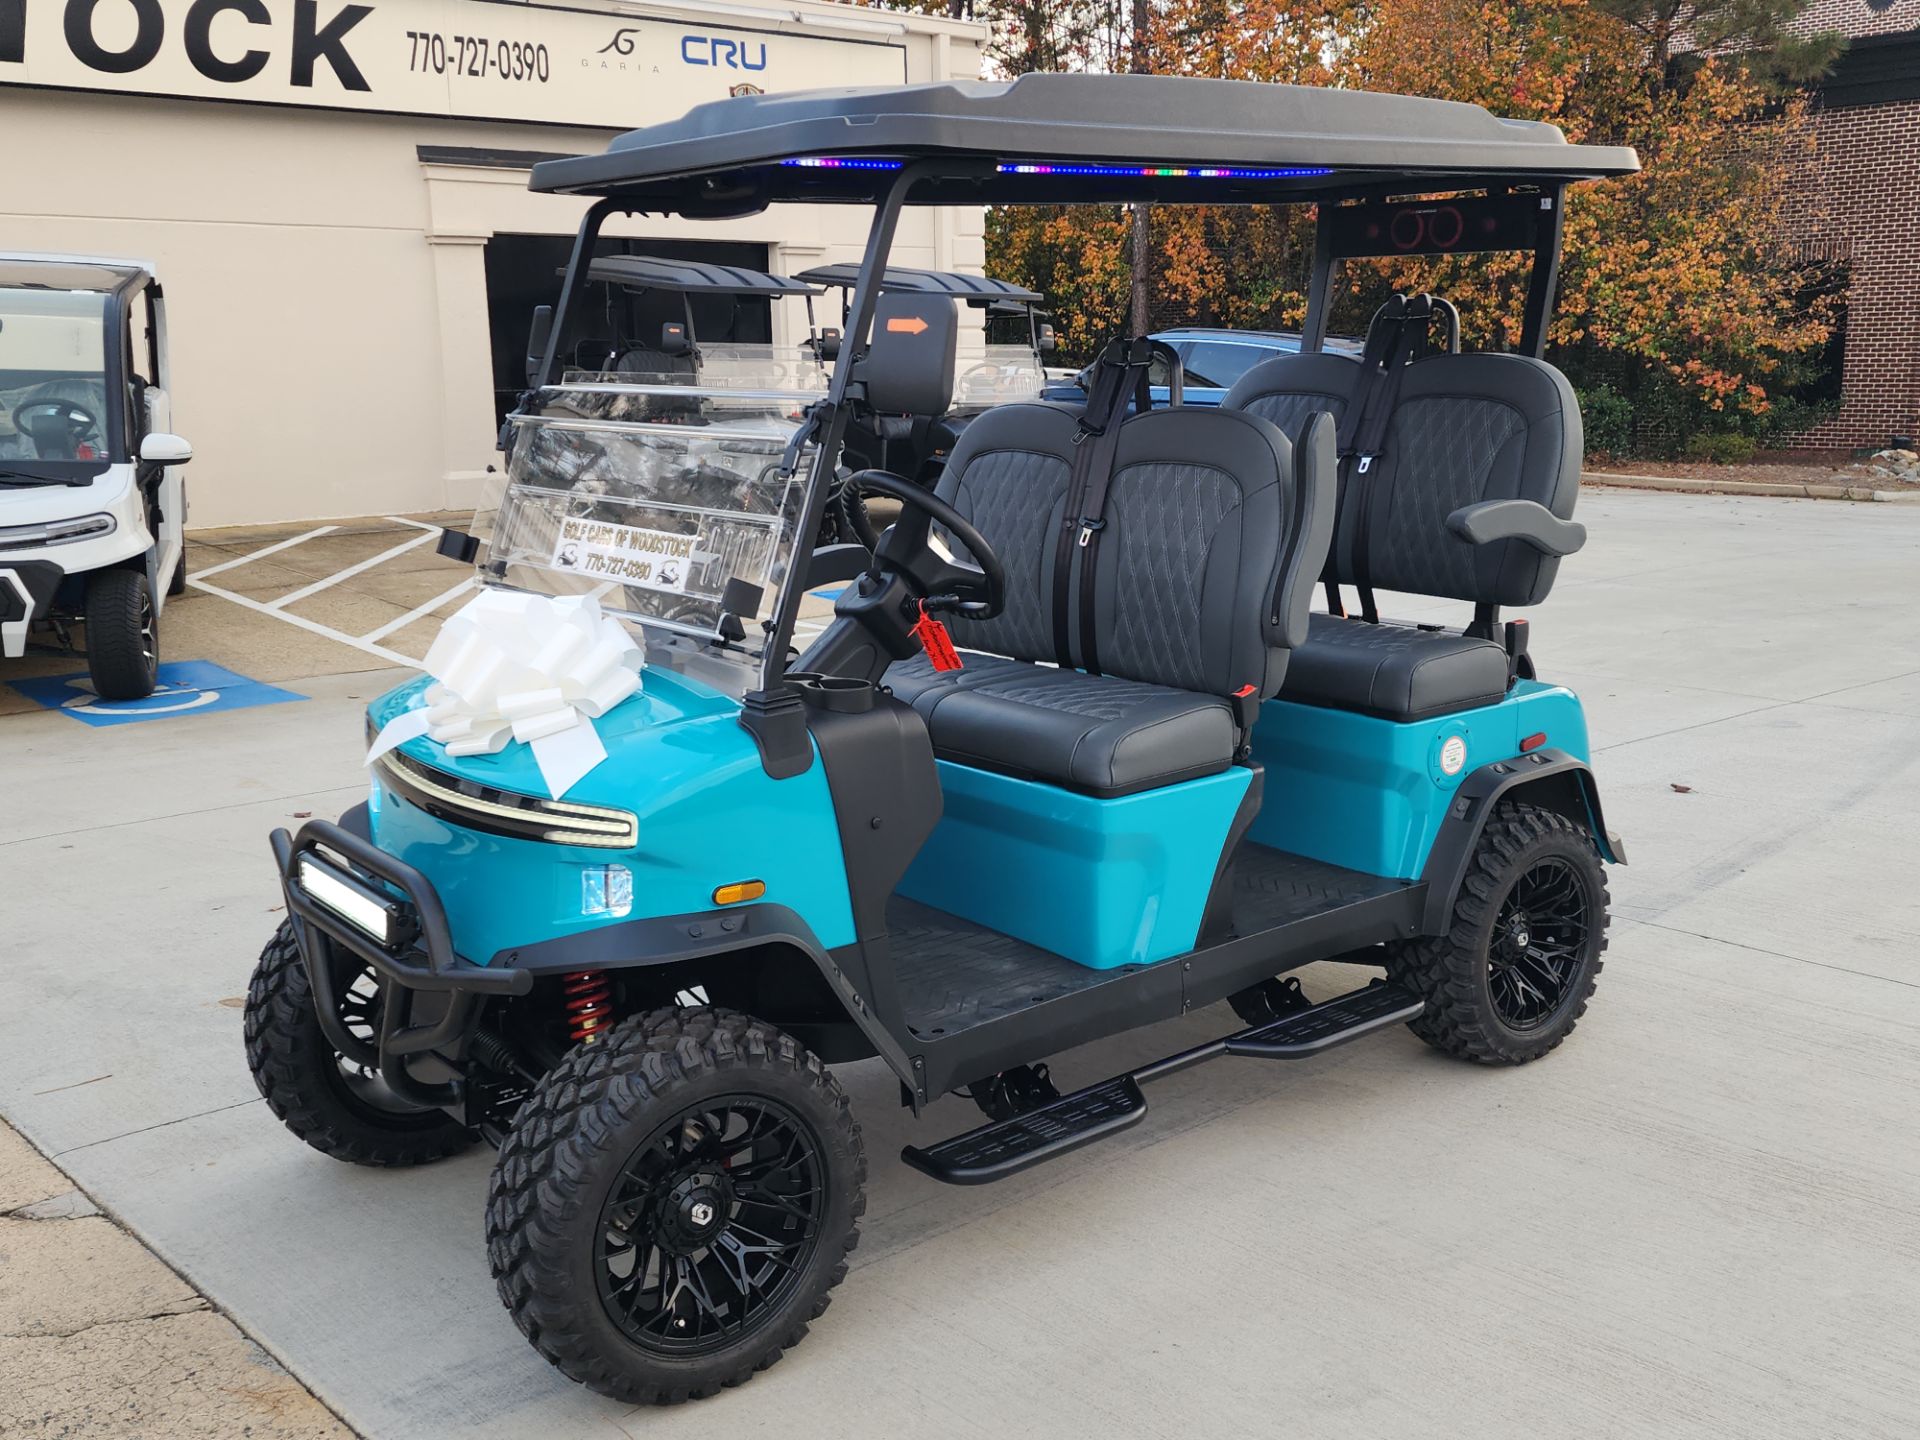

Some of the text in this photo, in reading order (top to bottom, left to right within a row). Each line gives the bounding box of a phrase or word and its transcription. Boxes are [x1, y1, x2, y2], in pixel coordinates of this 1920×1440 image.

[406, 31, 549, 83] 770-727-0390
[581, 58, 660, 73] GARIA
[681, 35, 766, 71] CRU
[565, 521, 694, 558] GOLF CARS OF WOODSTOCK
[584, 552, 652, 580] 770-727-0390
